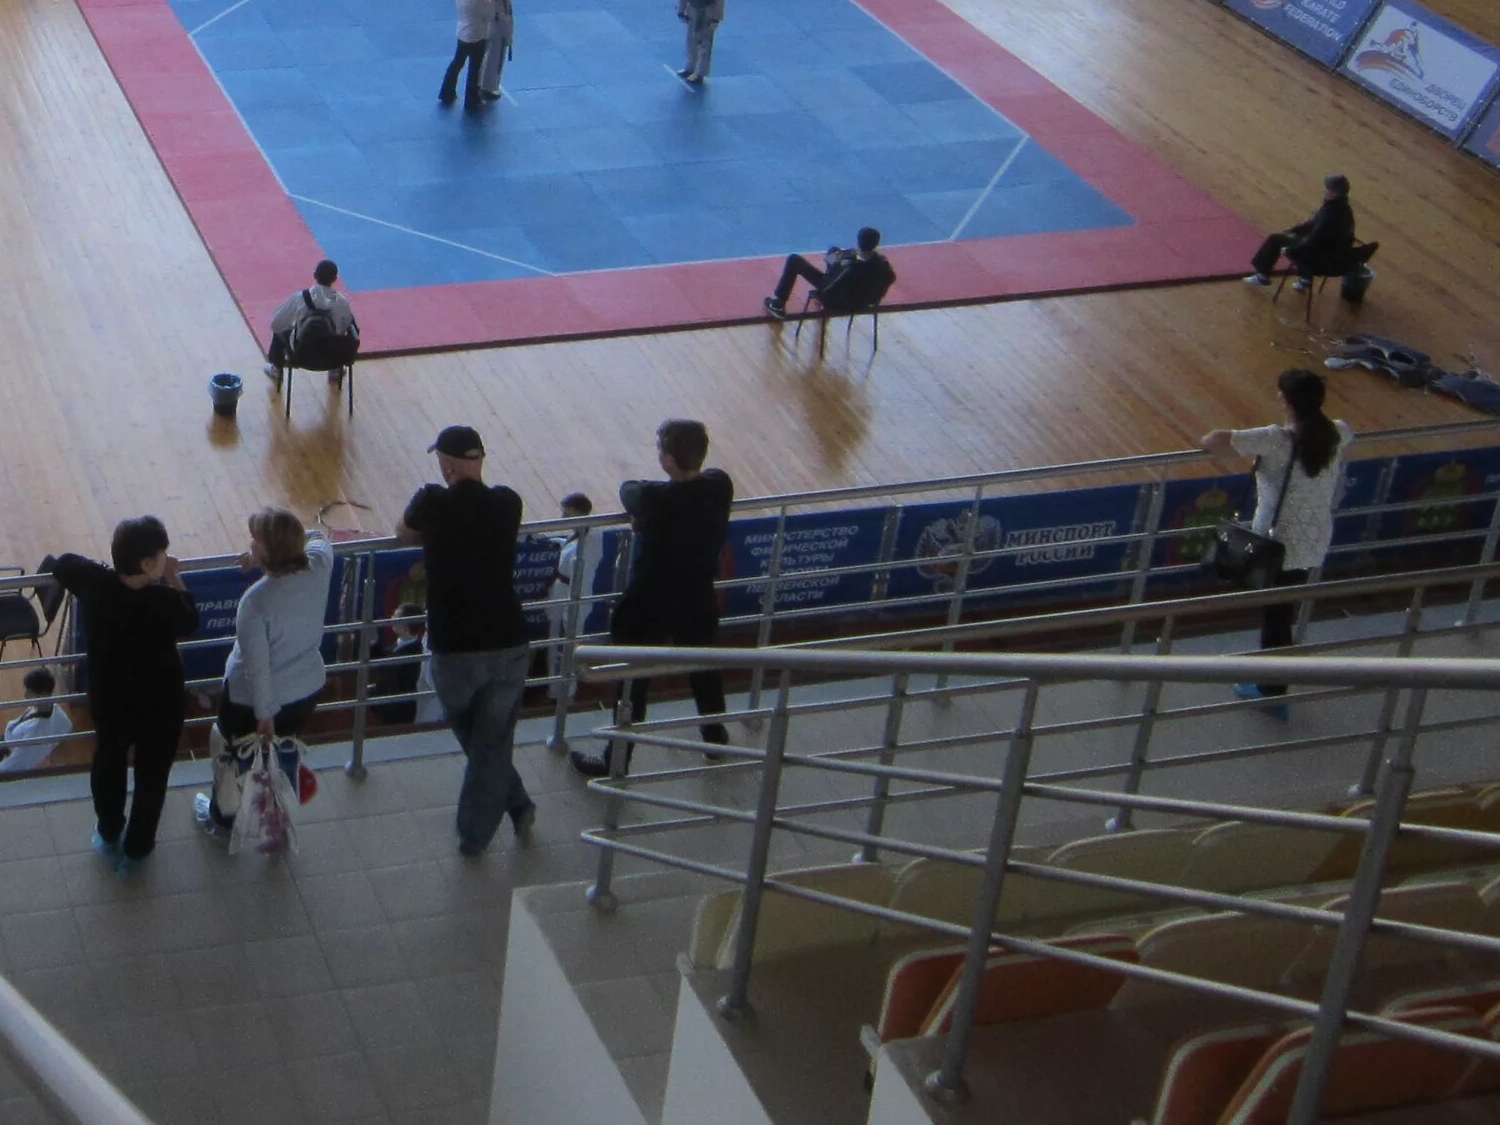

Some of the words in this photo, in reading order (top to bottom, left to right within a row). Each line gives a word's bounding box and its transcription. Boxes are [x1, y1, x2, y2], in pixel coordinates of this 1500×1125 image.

[1283, 3, 1342, 41] FEDERATION
[744, 525, 859, 545] МИНСТЕРСТВО
[1005, 521, 1116, 548] МИНСПОРТ
[750, 537, 849, 556] ФИИЧЕСКОЙ
